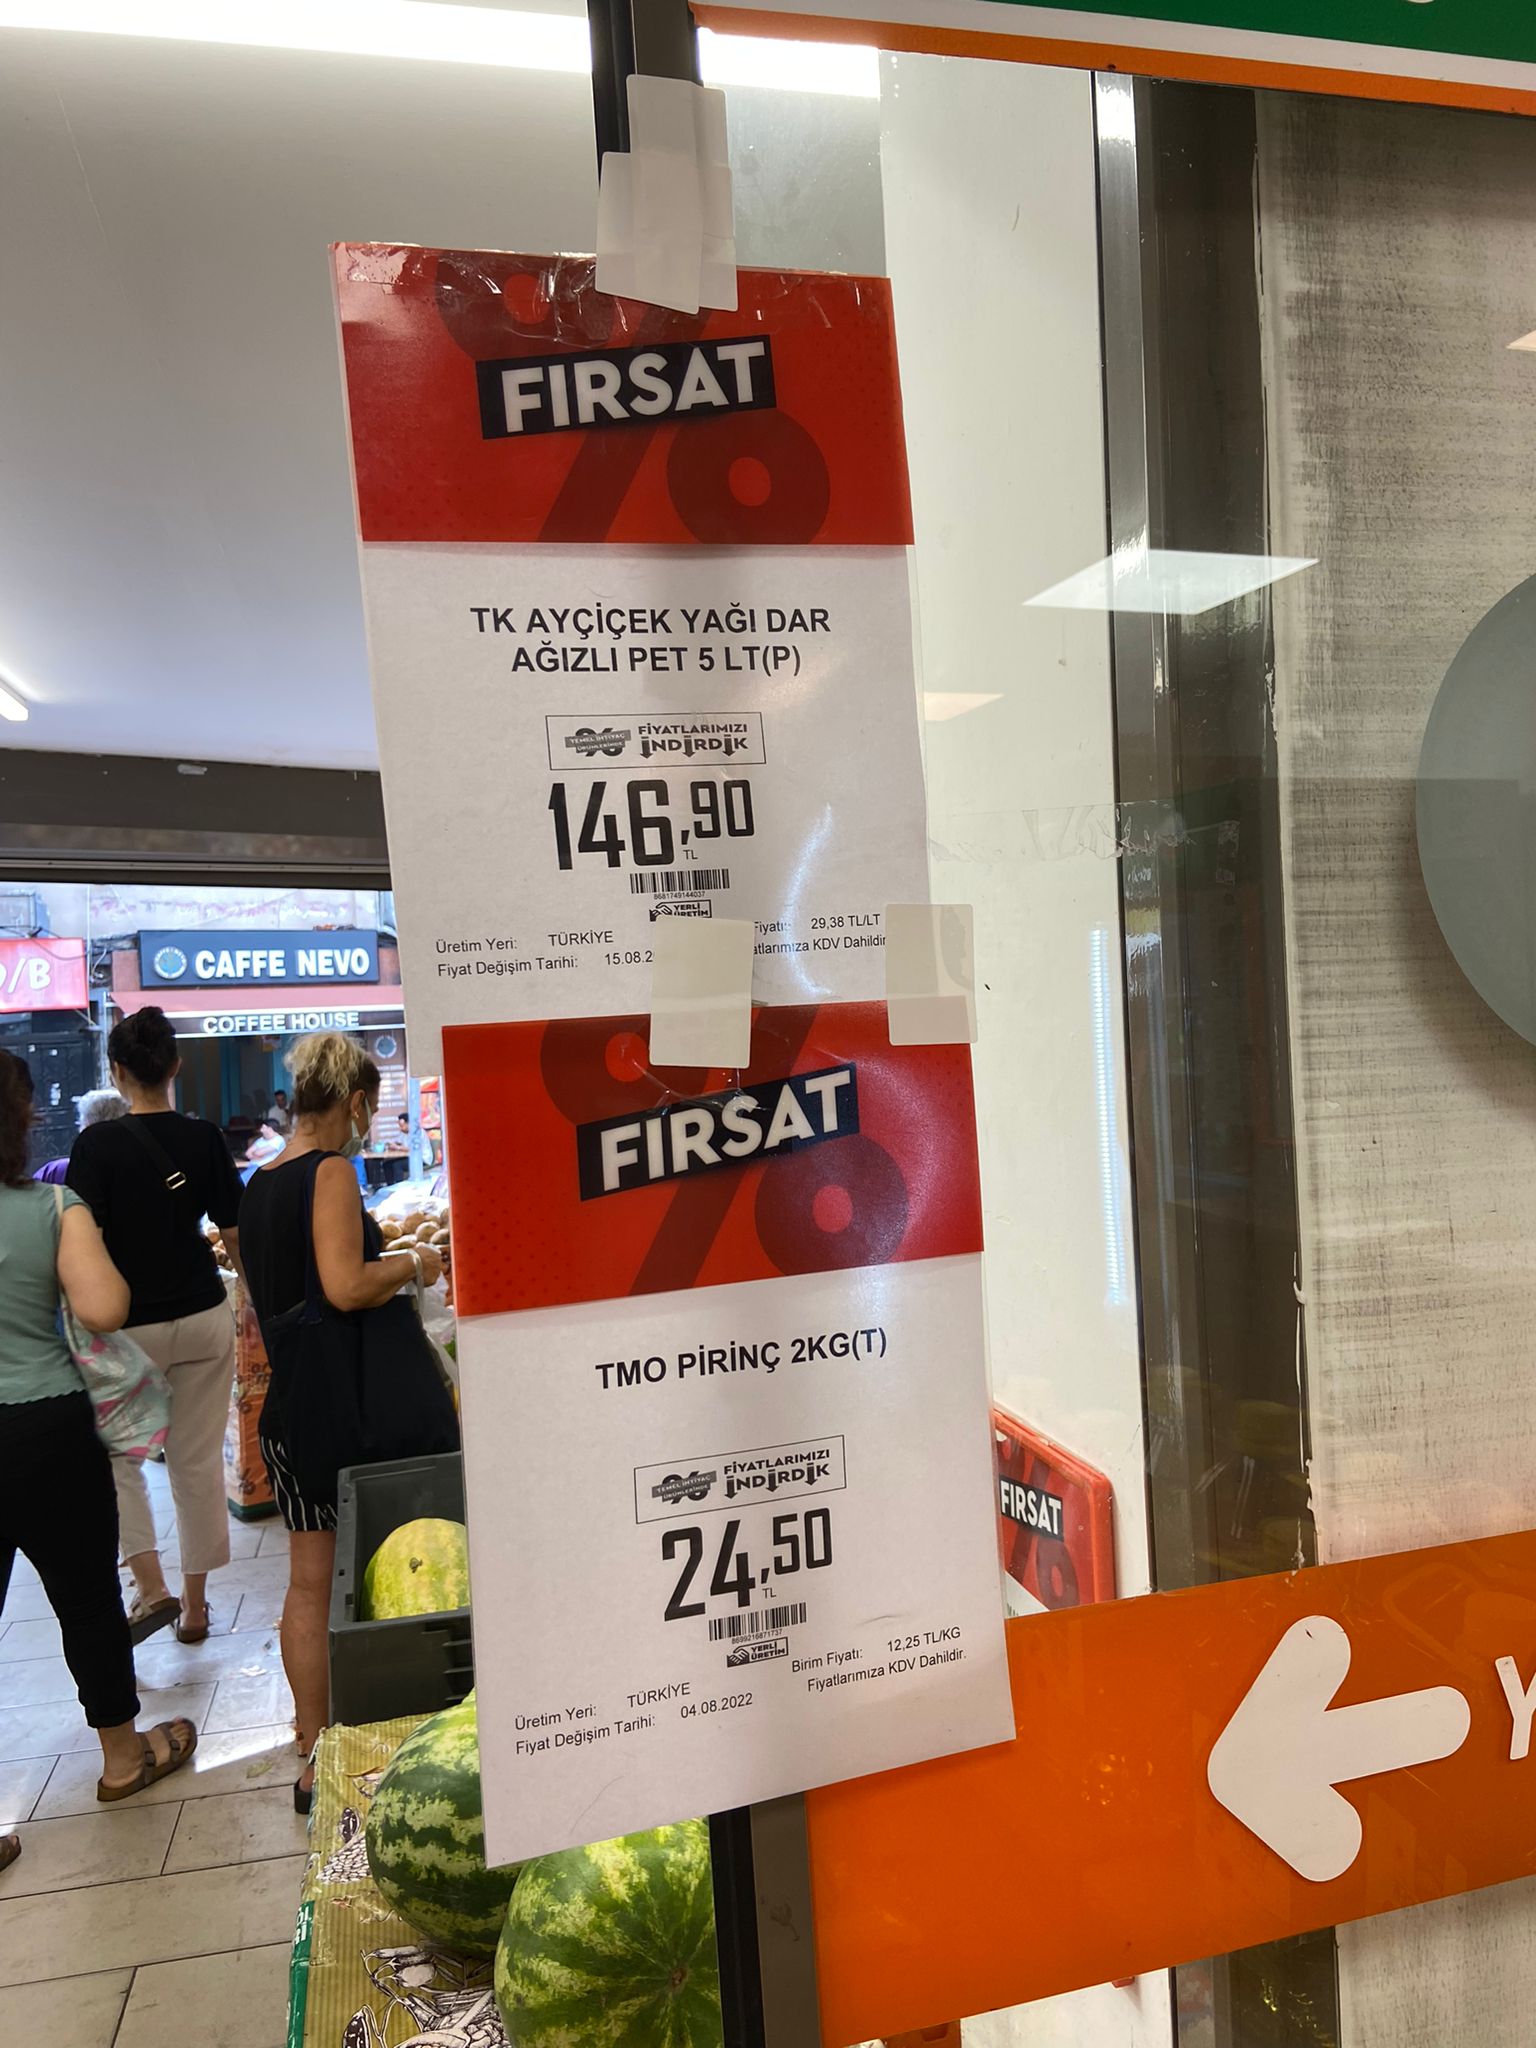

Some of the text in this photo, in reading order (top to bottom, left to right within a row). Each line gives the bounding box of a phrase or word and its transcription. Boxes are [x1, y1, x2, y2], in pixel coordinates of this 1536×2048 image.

[501, 341, 765, 432] FIRSAT
[470, 602, 831, 640] TK AYÇİÇEK YAĞI DAR
[512, 640, 801, 677] AĞIZLI PET 5 LT(P)
[638, 723, 748, 735] FİYATLARIMIZI
[548, 780, 755, 870] 146,90
[683, 850, 698, 859] TL
[811, 916, 845, 930] 29,38
[847, 914, 881, 927] TL/LT
[436, 930, 614, 953] Üretim Yeri: TÜRKİYE
[813, 938, 840, 951] KDV
[844, 935, 886, 949] Dahildir
[195, 949, 286, 979] CAFFE
[297, 948, 370, 977] NEVO
[438, 951, 653, 979] Fiyat Değişim Tarihi: 15.08.2
[203, 1012, 359, 1033] COFFEE HOUSE
[600, 1070, 852, 1191] FIRSAT
[595, 1327, 887, 1389] TMO PİRİNÇ 2KG(T)
[724, 1449, 830, 1475] FİYATLARIMIZI
[1000, 1480, 1062, 1535] FIRSAT
[662, 1508, 832, 1622] 24,50
[762, 1588, 777, 1599] TL
[792, 1626, 961, 1673] Birim Fiyatı: 12,25 TL/KG
[808, 1649, 967, 1692] Fiyatlarımıza KDV Dahildir.
[515, 1682, 691, 1731] Üretim Yeri: TÜRKİYE
[516, 1692, 753, 1756] Fiyat Değişim Tarihi: 04.08.2022
